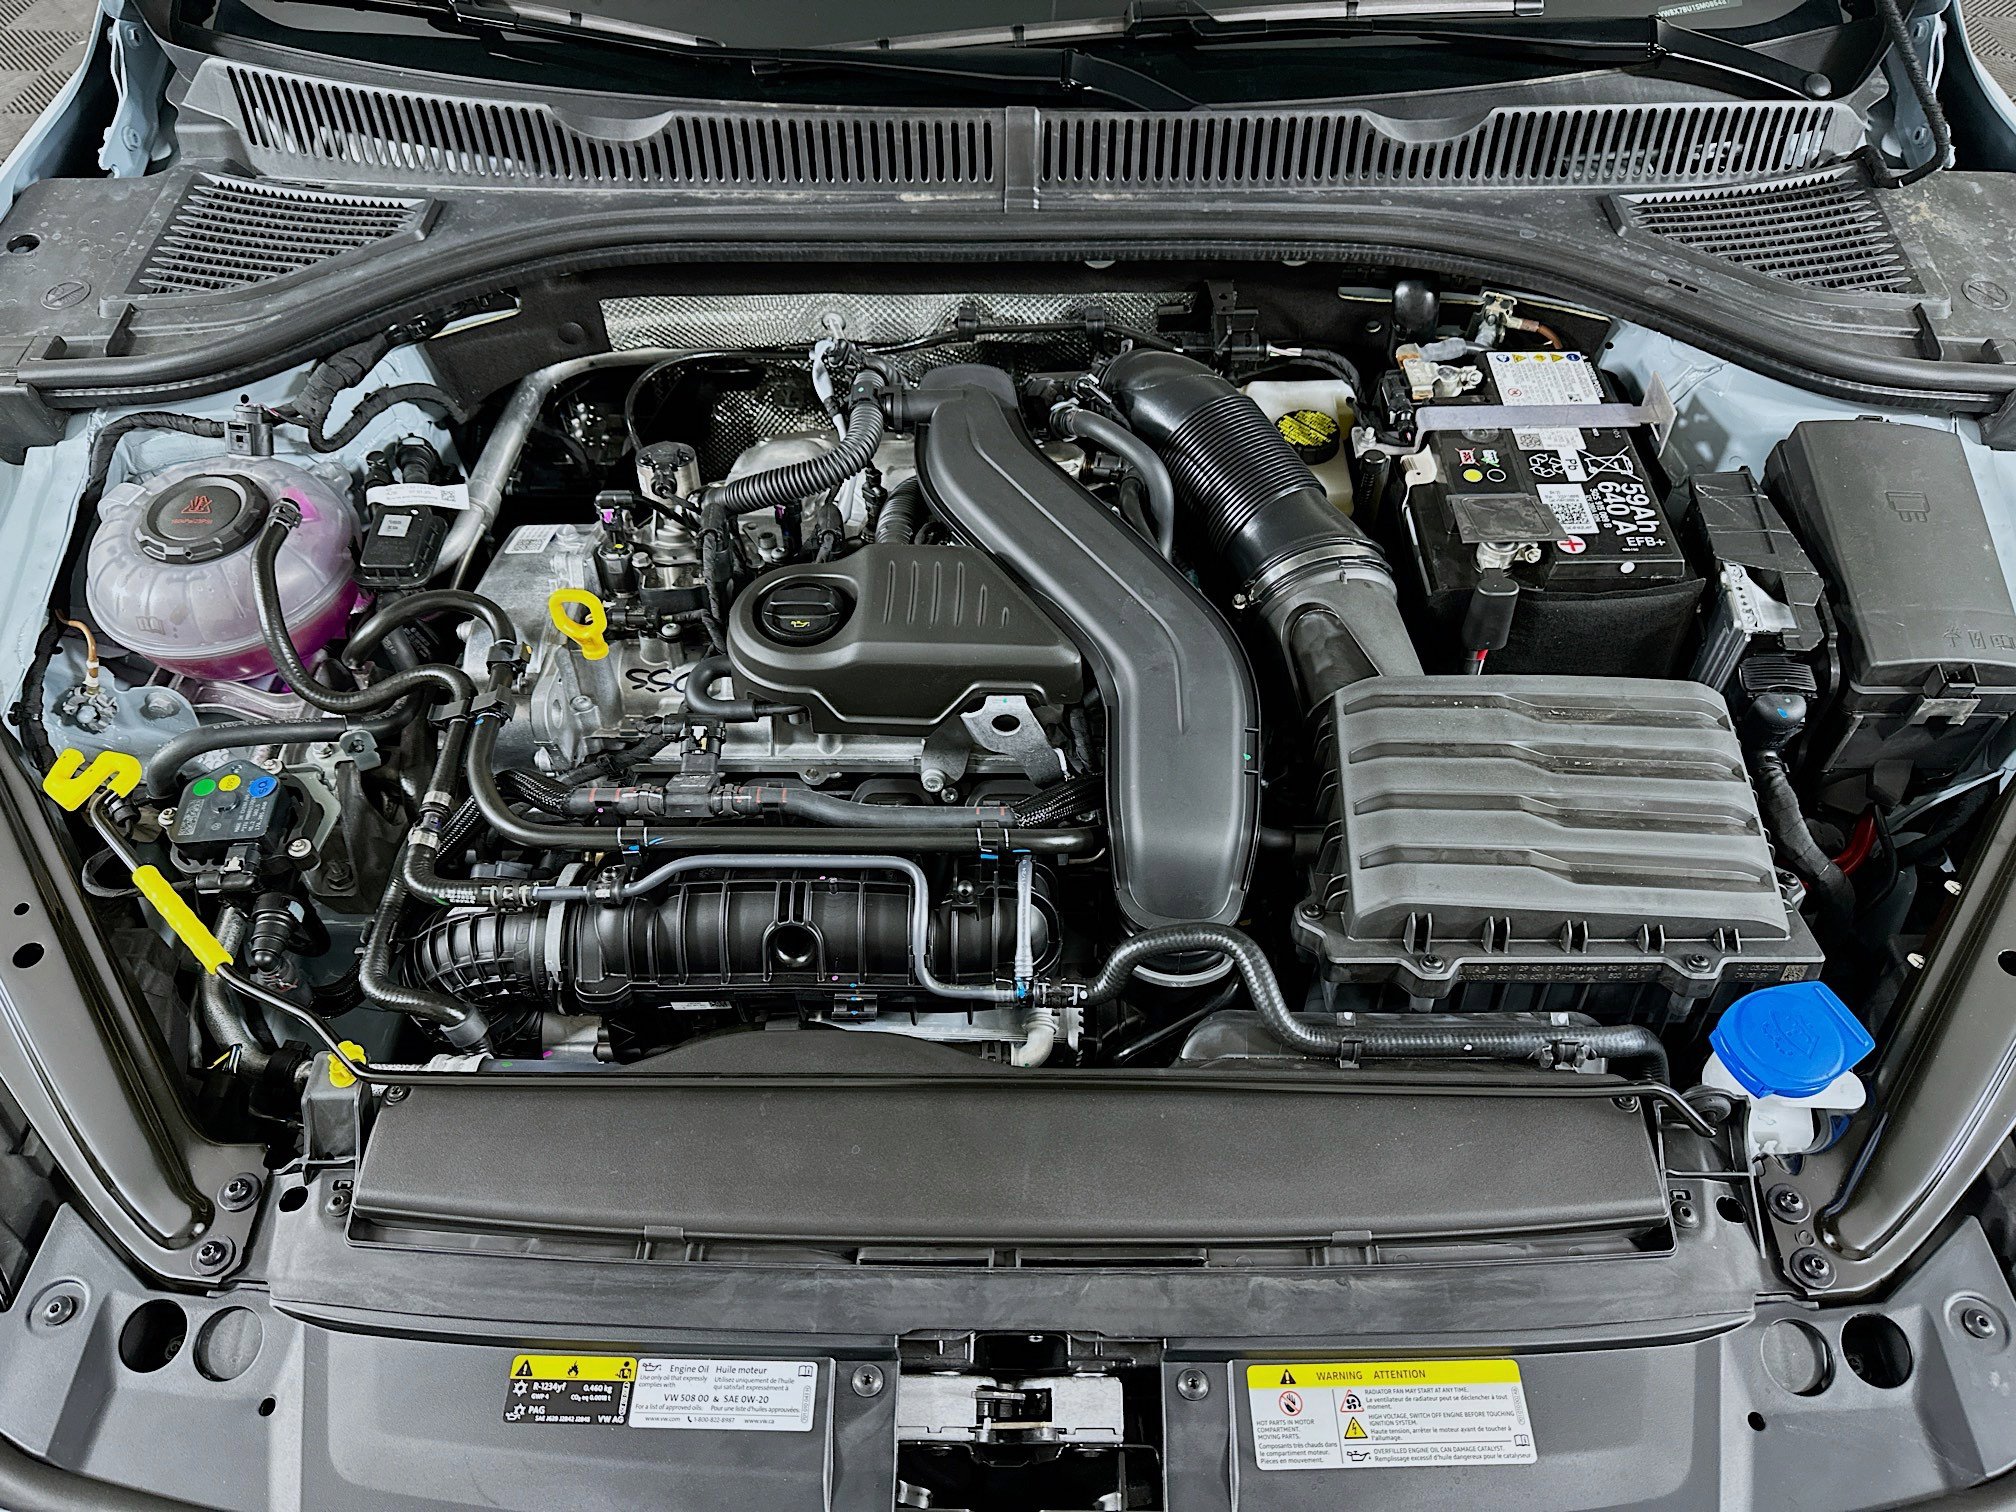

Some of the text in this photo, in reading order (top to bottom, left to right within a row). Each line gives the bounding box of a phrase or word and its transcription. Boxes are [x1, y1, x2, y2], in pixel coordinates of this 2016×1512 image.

[1565, 459, 1578, 470] Pb
[1597, 481, 1630, 516] 640
[1621, 483, 1660, 533] 59Ah
[1611, 520, 1638, 535] A
[1626, 536, 1666, 547] EFB+
[670, 1365, 709, 1374] Engine Oil
[716, 1366, 767, 1374] Huile moteur
[1316, 1369, 1426, 1380] WARNING ATTENTION
[532, 1382, 567, 1393] R-1234yf
[604, 1385, 613, 1394] kg
[680, 1394, 695, 1402] 508
[698, 1394, 709, 1402] 00
[528, 1406, 546, 1414] PAG
[597, 1415, 612, 1423] VW
[612, 1415, 624, 1424] AG
